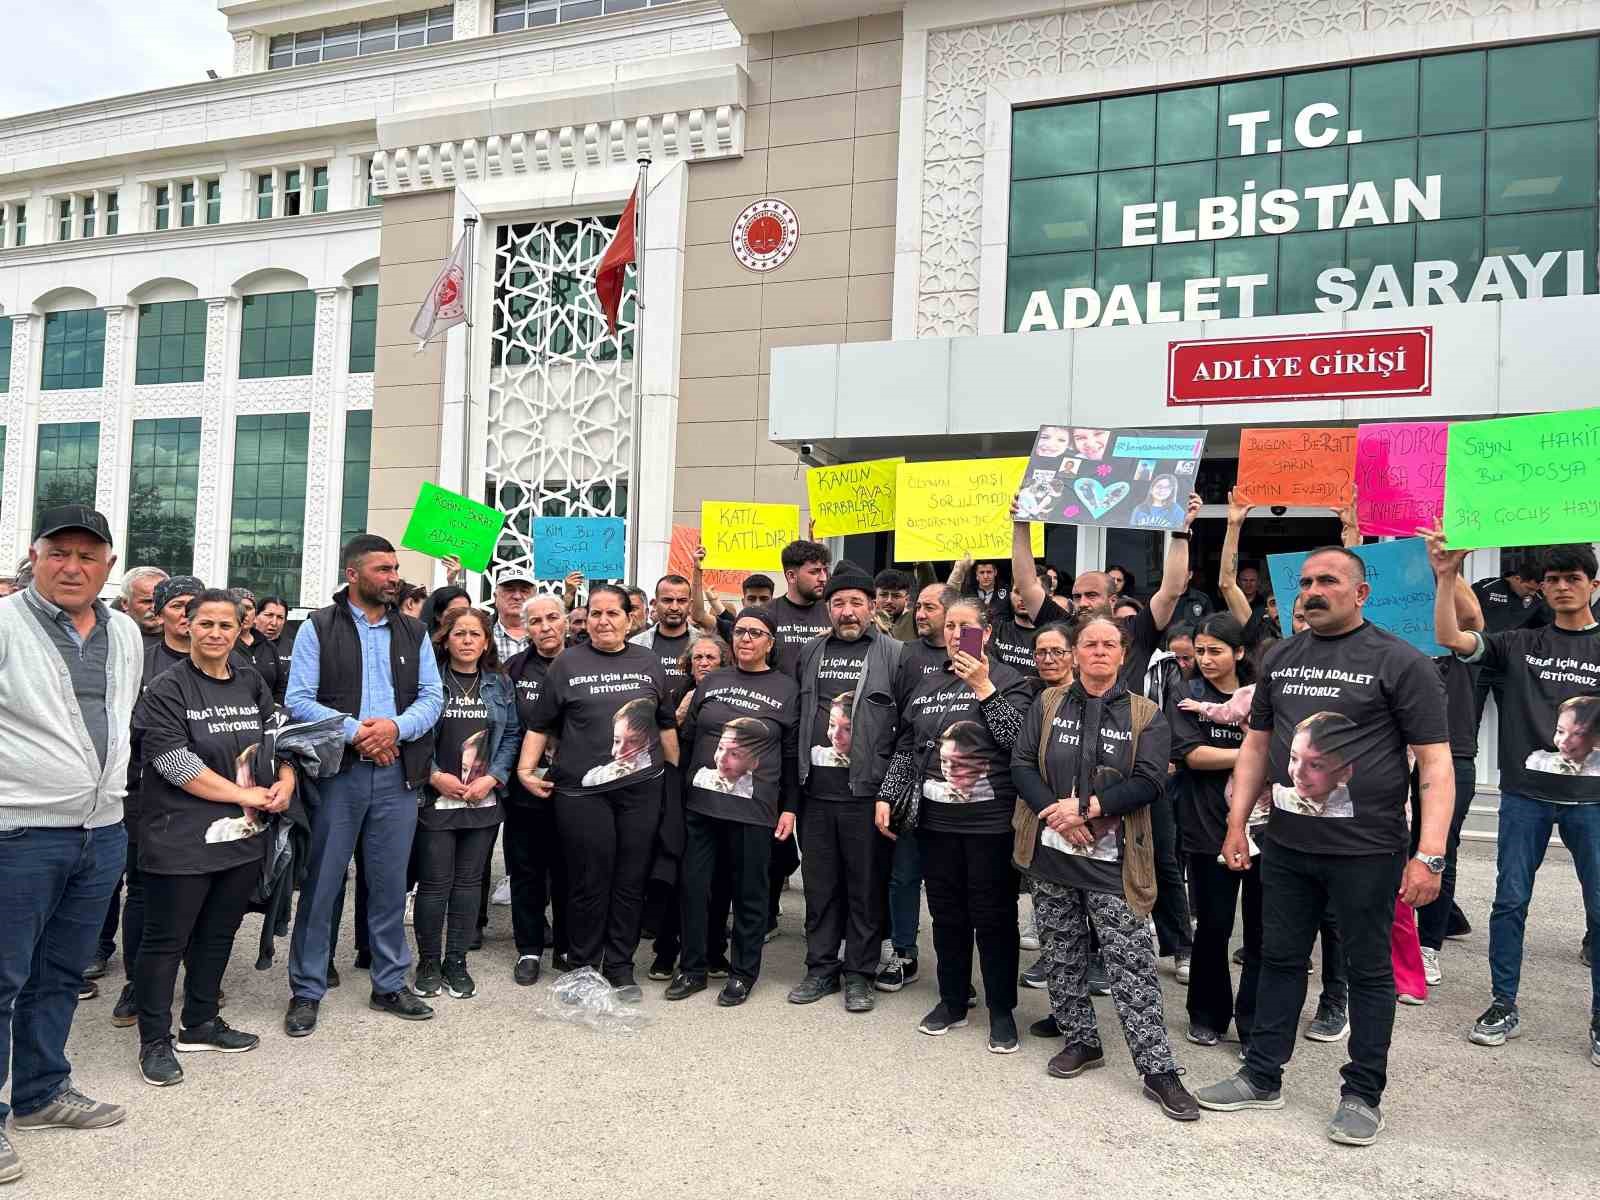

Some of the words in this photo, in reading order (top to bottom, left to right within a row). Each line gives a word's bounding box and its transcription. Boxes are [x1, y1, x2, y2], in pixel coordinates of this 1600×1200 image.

[1121, 174, 1442, 247] ELBİSTAN
[1016, 273, 1269, 333] ADALET
[1314, 249, 1585, 313] SARAYI
[1191, 356, 1302, 382] ADLİYE
[1308, 345, 1407, 377] GİRİŞİ
[600, 673, 621, 683] İÇİN
[1299, 665, 1324, 681] İÇİN
[1325, 669, 1374, 686] ADALET
[1539, 670, 1598, 687] İSTİYORUZ
[589, 682, 641, 695] İSTİYORUZ
[1282, 683, 1342, 698] İSTİYORUZ
[749, 691, 783, 710] ADALET
[214, 704, 239, 719] İÇİN
[207, 720, 260, 734] İSTİYORUZ
[1052, 716, 1075, 729] RAT
